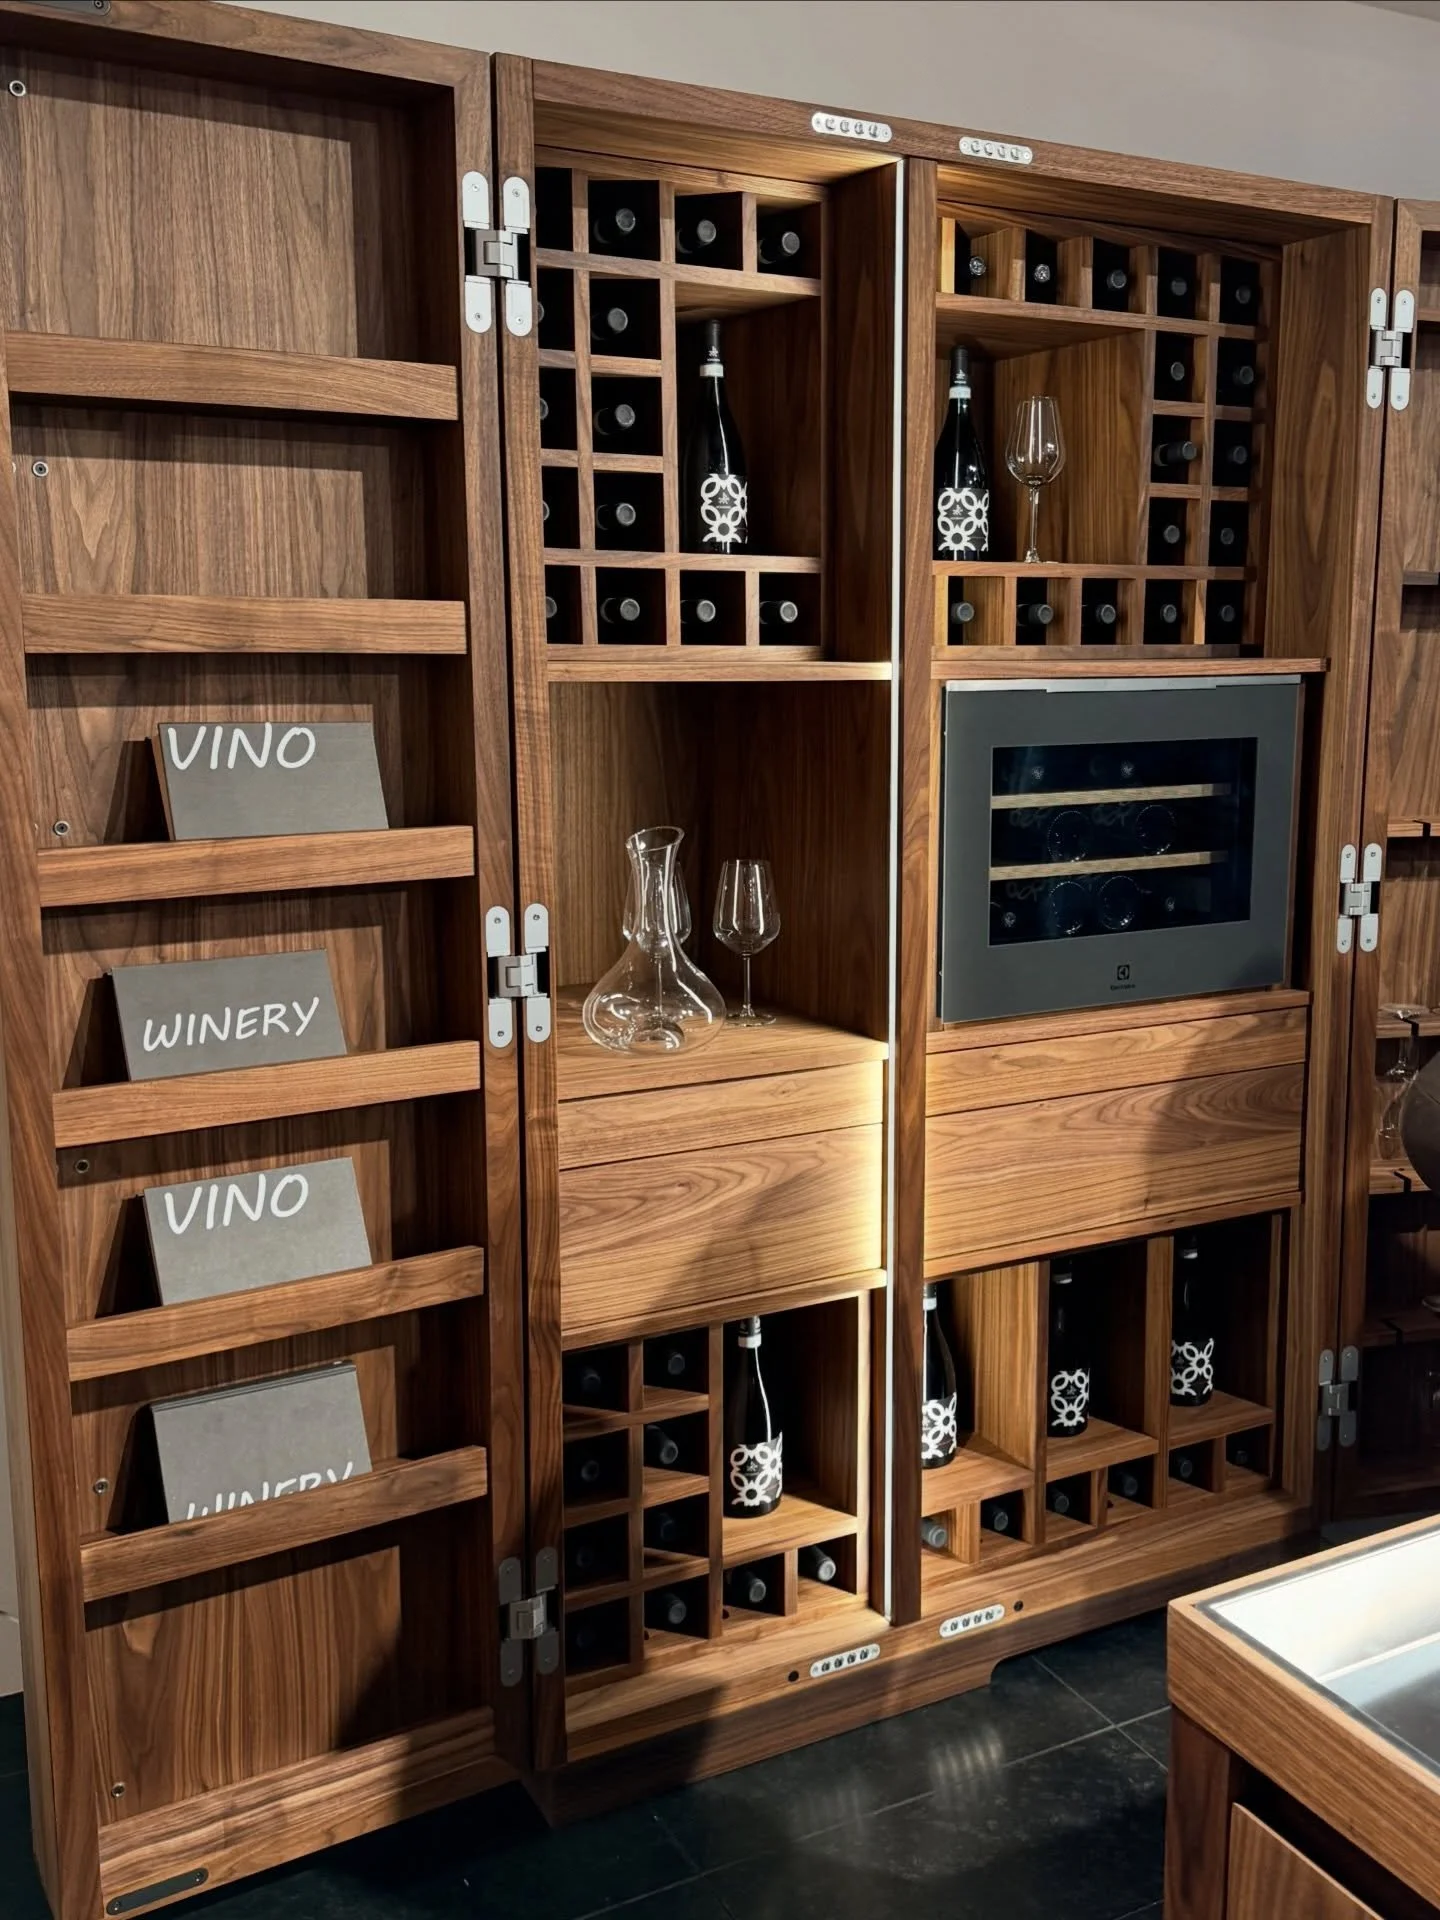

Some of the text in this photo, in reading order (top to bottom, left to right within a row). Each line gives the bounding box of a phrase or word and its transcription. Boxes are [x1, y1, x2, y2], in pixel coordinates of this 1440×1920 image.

[167, 722, 316, 770] VINO
[143, 996, 320, 1052] WINERY
[164, 1173, 309, 1235] VINO
